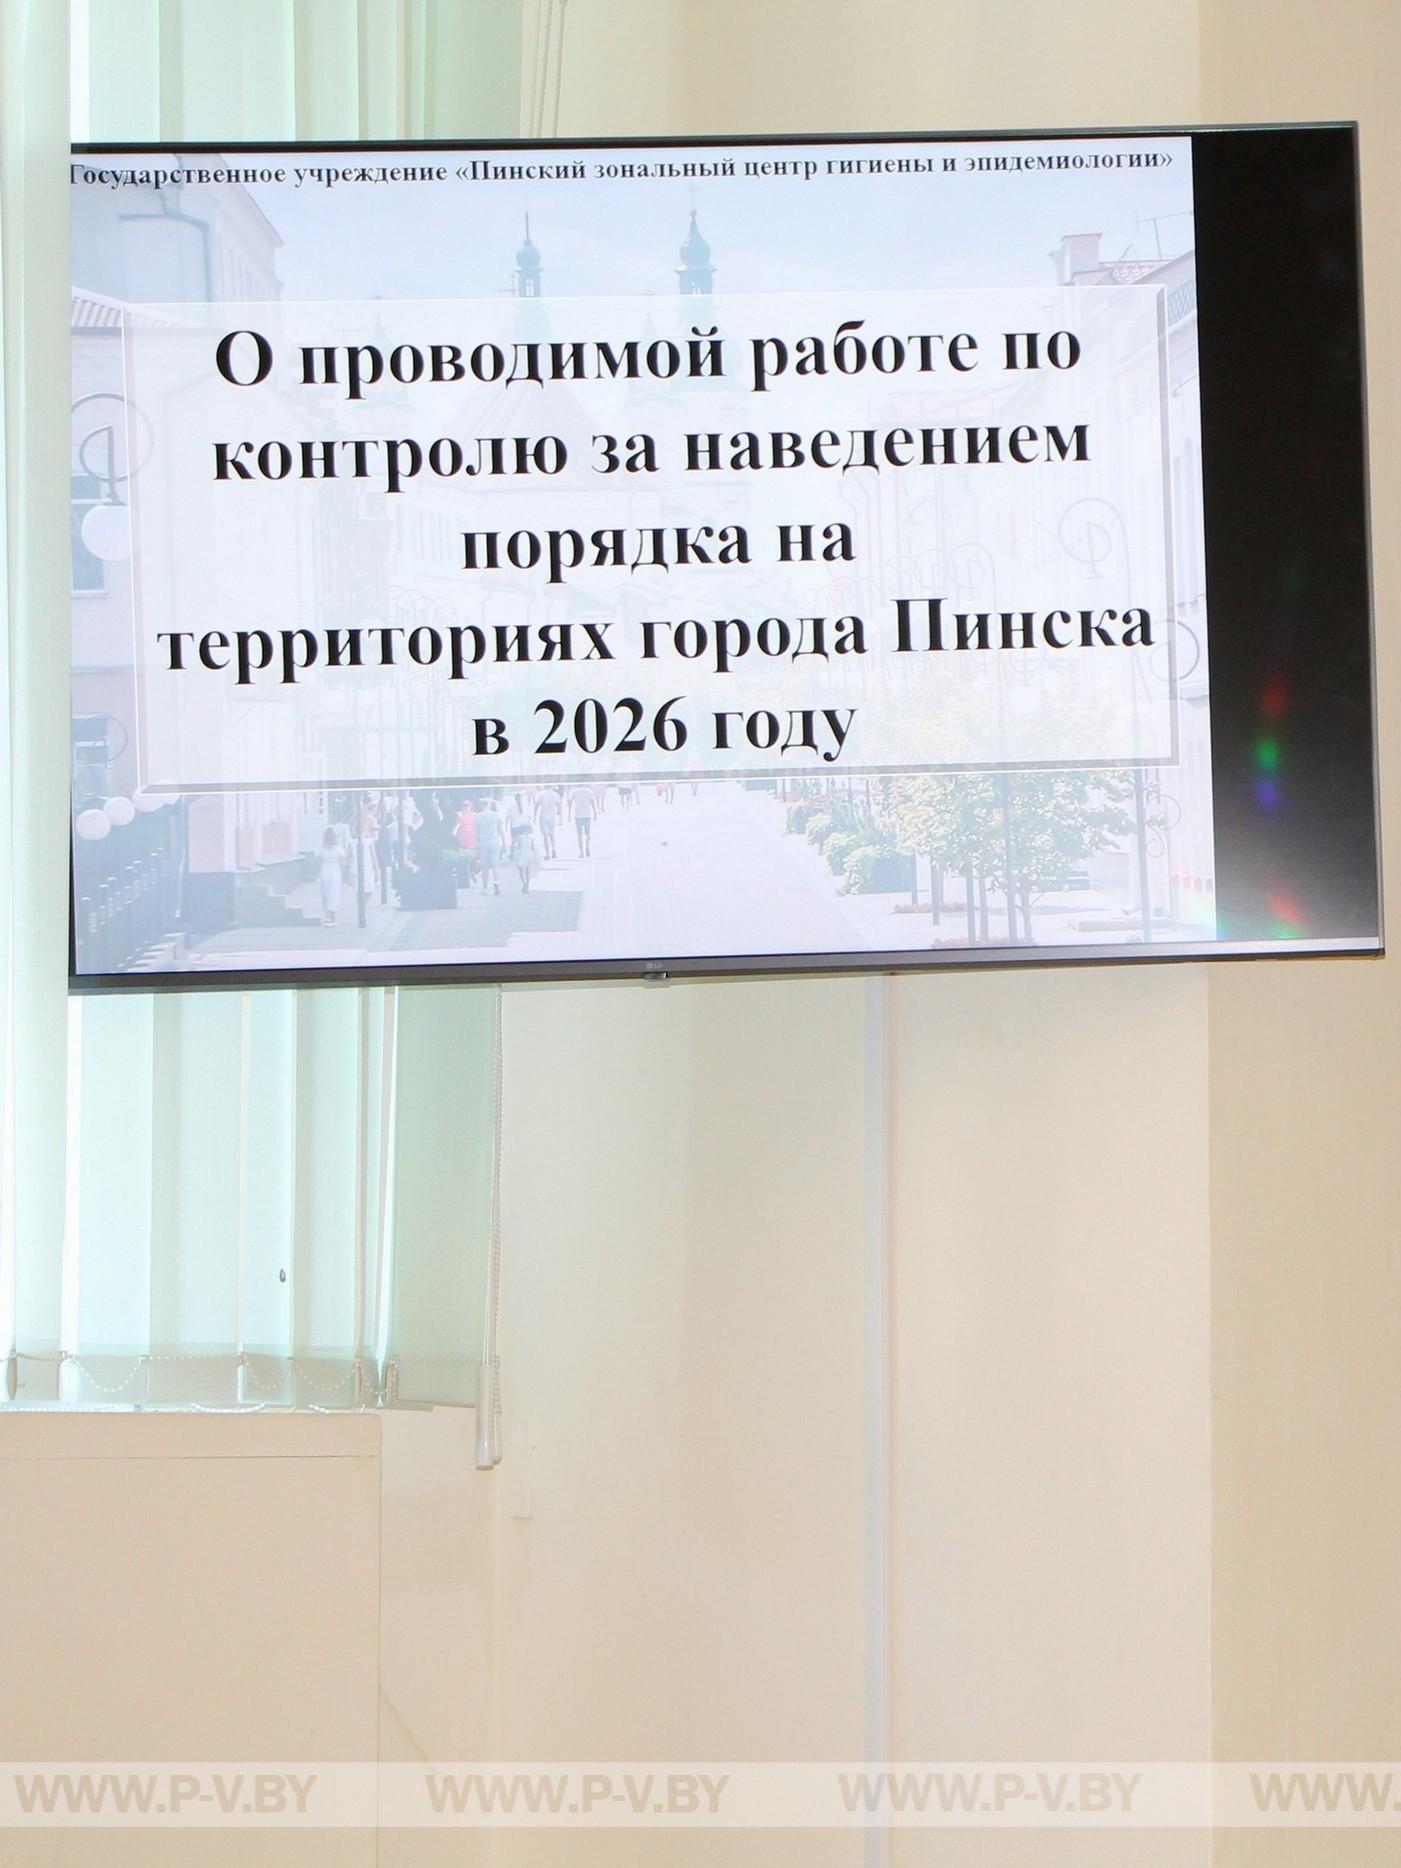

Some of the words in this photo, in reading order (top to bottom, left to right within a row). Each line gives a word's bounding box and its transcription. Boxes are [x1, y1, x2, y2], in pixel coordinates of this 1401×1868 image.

[71, 163, 286, 189] Государственное
[294, 166, 448, 188] учреждение
[455, 160, 586, 181] «Пинский
[594, 158, 736, 179] зональный
[744, 159, 817, 180] центр
[826, 157, 933, 175] гигиены
[942, 157, 957, 172] и
[965, 152, 1173, 173] эпидемиологии»
[215, 330, 273, 387] О
[299, 326, 727, 400] проводимой
[751, 319, 979, 391] работе
[1002, 328, 1081, 371] по
[212, 432, 568, 493] контролю
[591, 433, 660, 473] за
[685, 423, 1090, 475] наведением
[462, 525, 752, 583] порядка
[776, 522, 856, 562] на
[157, 622, 617, 685] территориях
[641, 614, 868, 673] города
[891, 597, 1156, 653] Пинска
[472, 717, 509, 756] в
[534, 696, 688, 754] 2026
[712, 707, 857, 762] году
